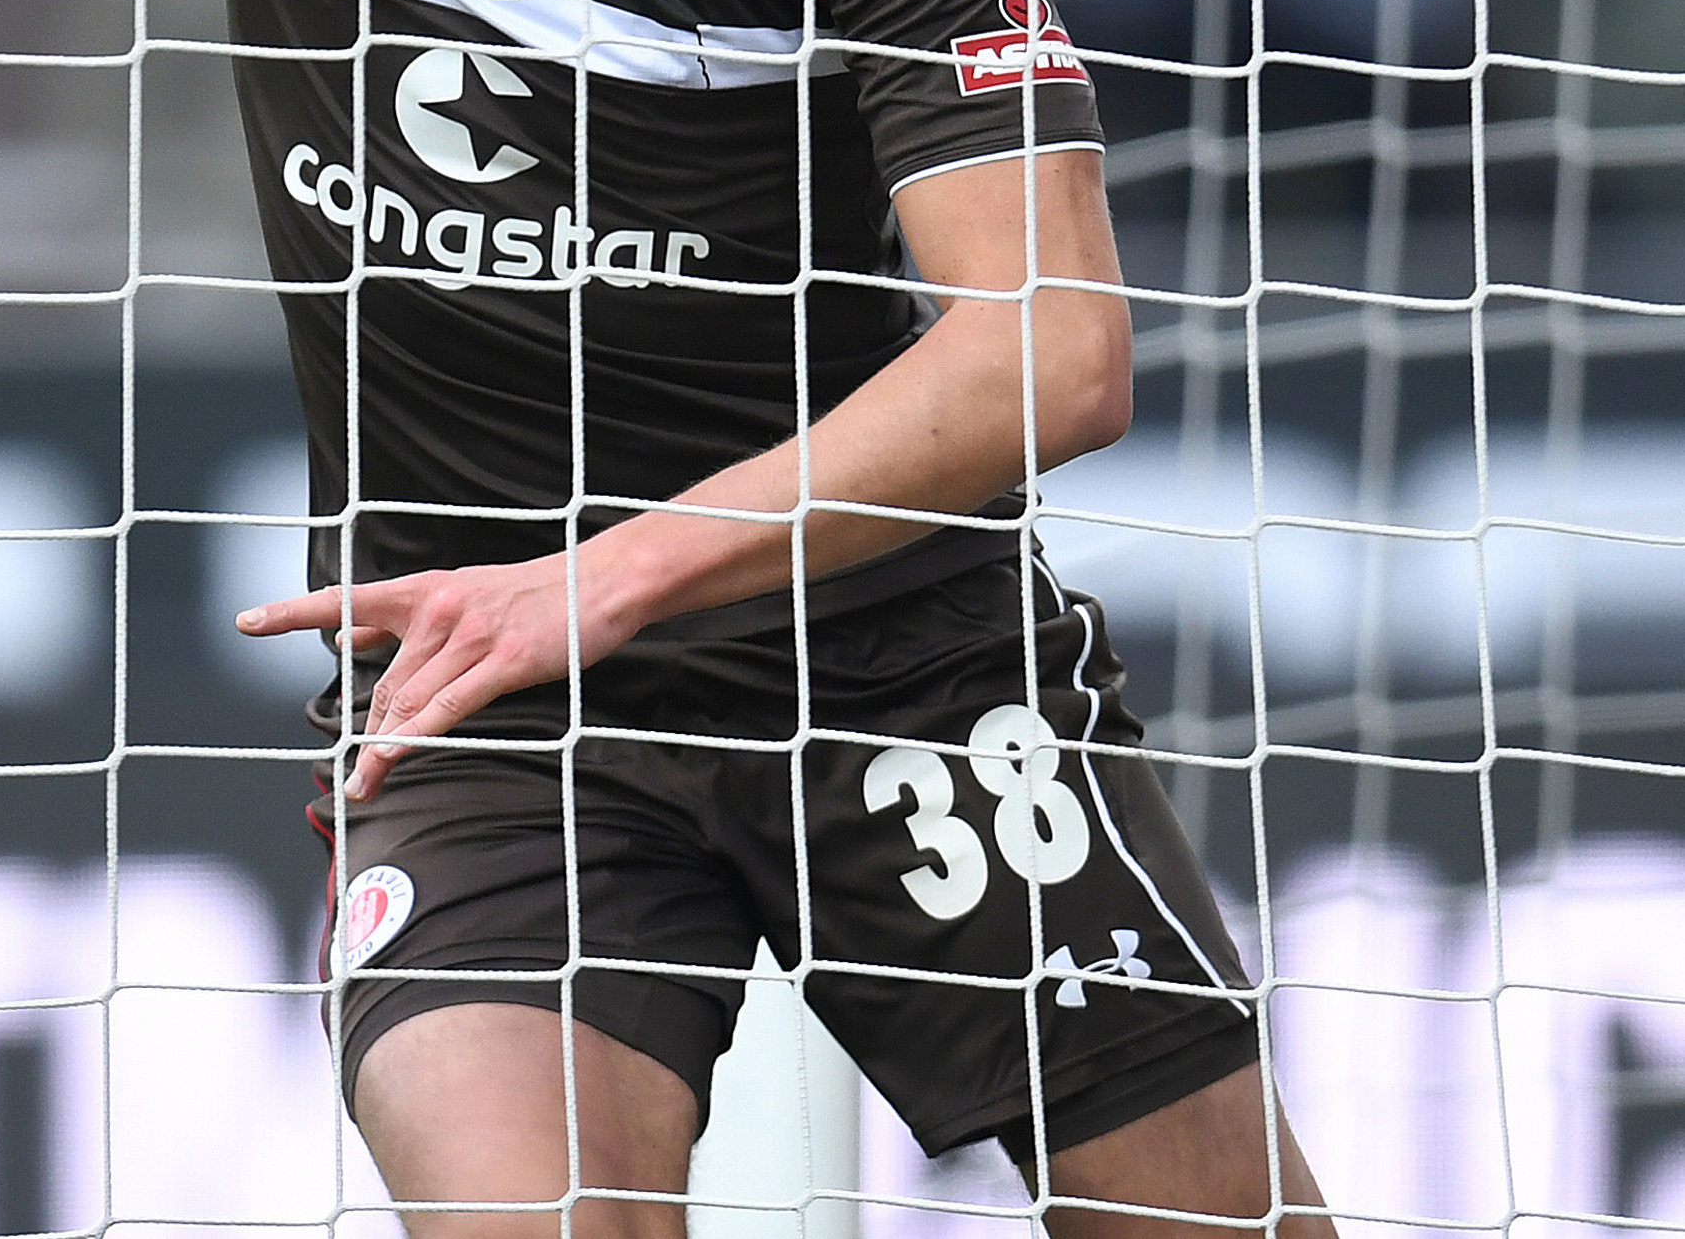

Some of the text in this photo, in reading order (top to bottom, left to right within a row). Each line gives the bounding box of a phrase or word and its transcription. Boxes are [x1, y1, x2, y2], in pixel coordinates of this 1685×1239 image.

[283, 143, 711, 292] congstar
[365, 871, 407, 899] PAULI
[863, 703, 1091, 921] 38
